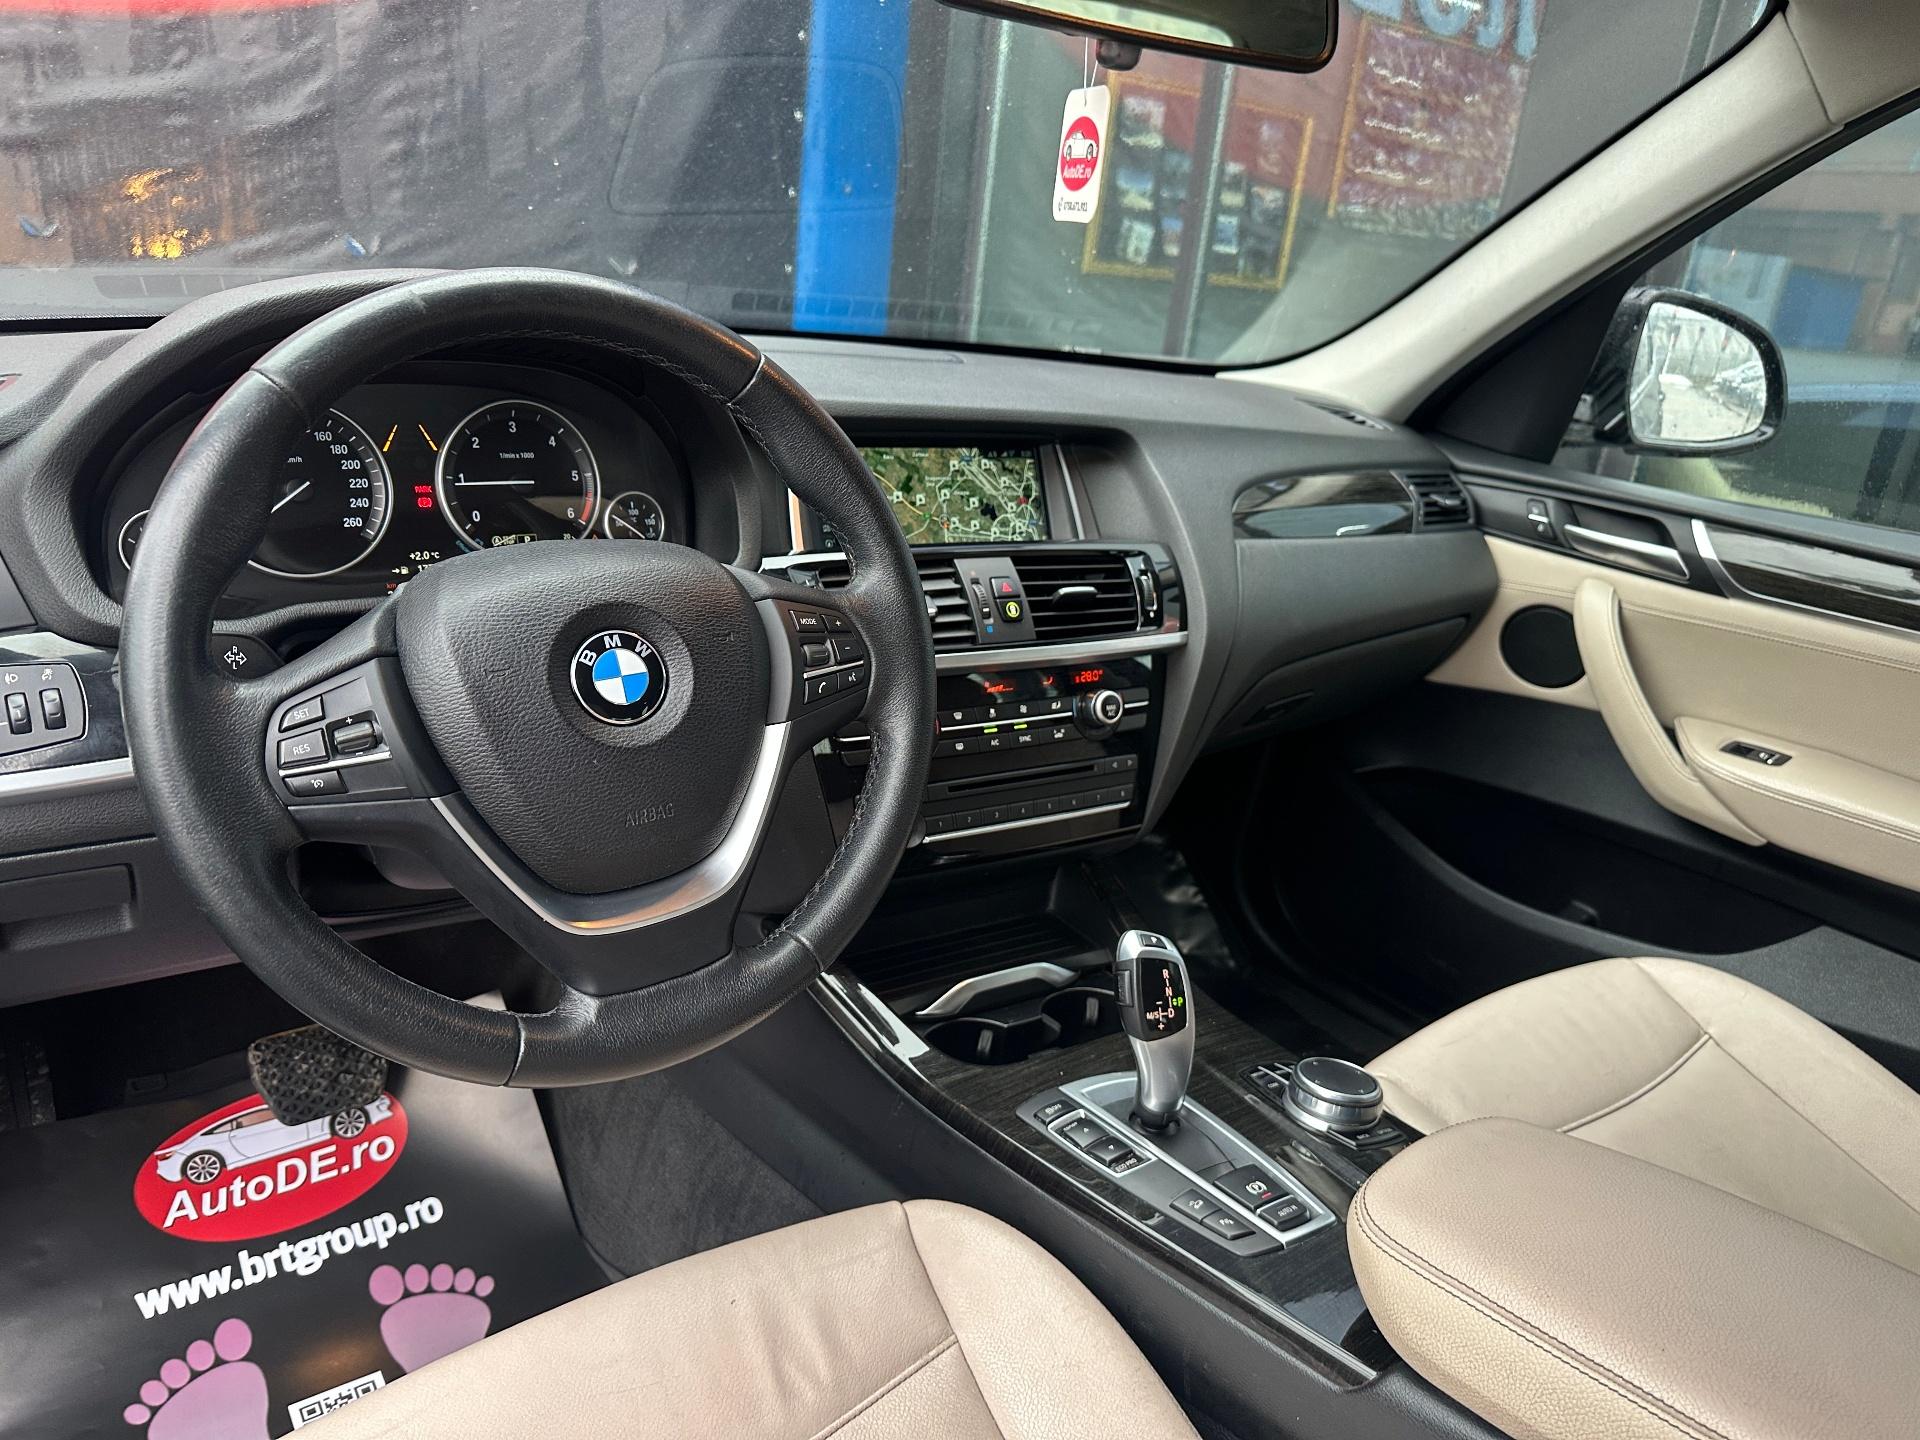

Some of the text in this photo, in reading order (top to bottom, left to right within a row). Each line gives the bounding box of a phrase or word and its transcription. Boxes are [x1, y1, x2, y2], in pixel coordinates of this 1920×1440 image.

[508, 421, 517, 433] 3
[314, 431, 333, 441] 160
[548, 436, 557, 447] 4
[471, 437, 480, 449] 2
[330, 444, 348, 455] 180
[341, 460, 361, 470] 200
[571, 470, 579, 481] 5
[349, 478, 369, 489] 220
[349, 498, 369, 508] 240
[472, 511, 481, 522] 0
[567, 507, 575, 519] 6
[343, 517, 363, 528] 260
[409, 551, 430, 561] +2.0
[800, 617, 818, 625] MODE
[232, 645, 238, 654] R
[579, 634, 652, 667] BMW
[293, 707, 310, 720] SET
[292, 743, 311, 756] RES
[625, 802, 675, 828] AIRBAG
[1162, 969, 1170, 979] R
[1165, 986, 1173, 997] N
[1177, 996, 1184, 1007] P
[1167, 1007, 1175, 1018] D
[163, 1135, 396, 1228] AutoDE.ro
[133, 1196, 444, 1319] www.brtgroup.ro
